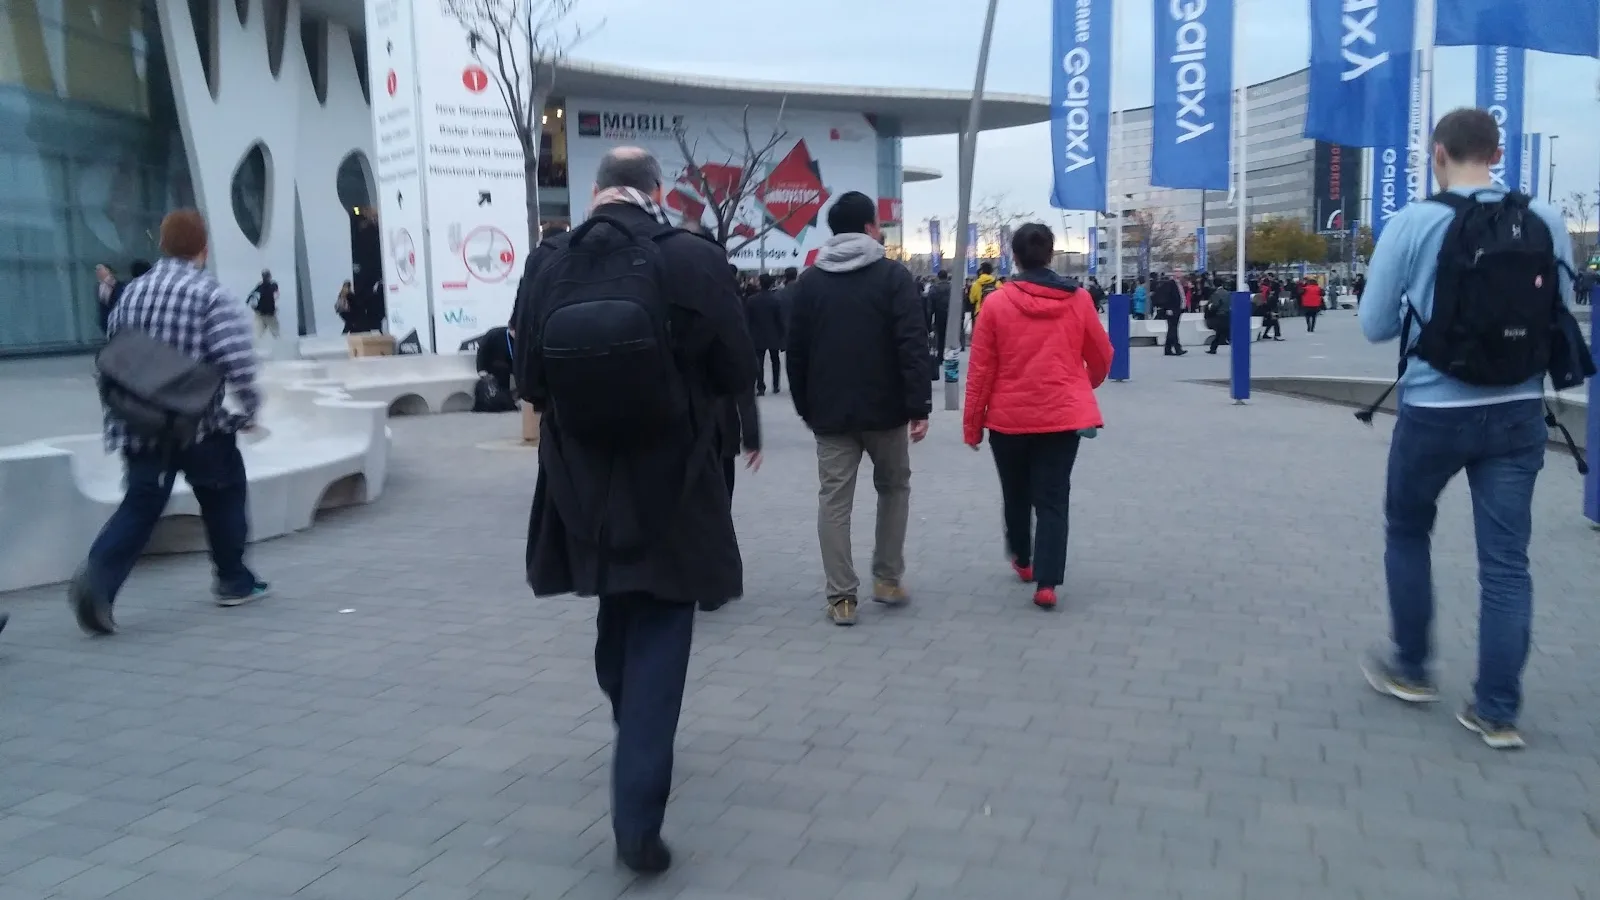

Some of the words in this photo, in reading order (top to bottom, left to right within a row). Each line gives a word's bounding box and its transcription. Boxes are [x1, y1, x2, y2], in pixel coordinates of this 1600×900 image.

[603, 111, 684, 131] MOBILE
[463, 146, 490, 158] World
[478, 167, 525, 180] Programm
[1329, 144, 1341, 200] ONGRESS
